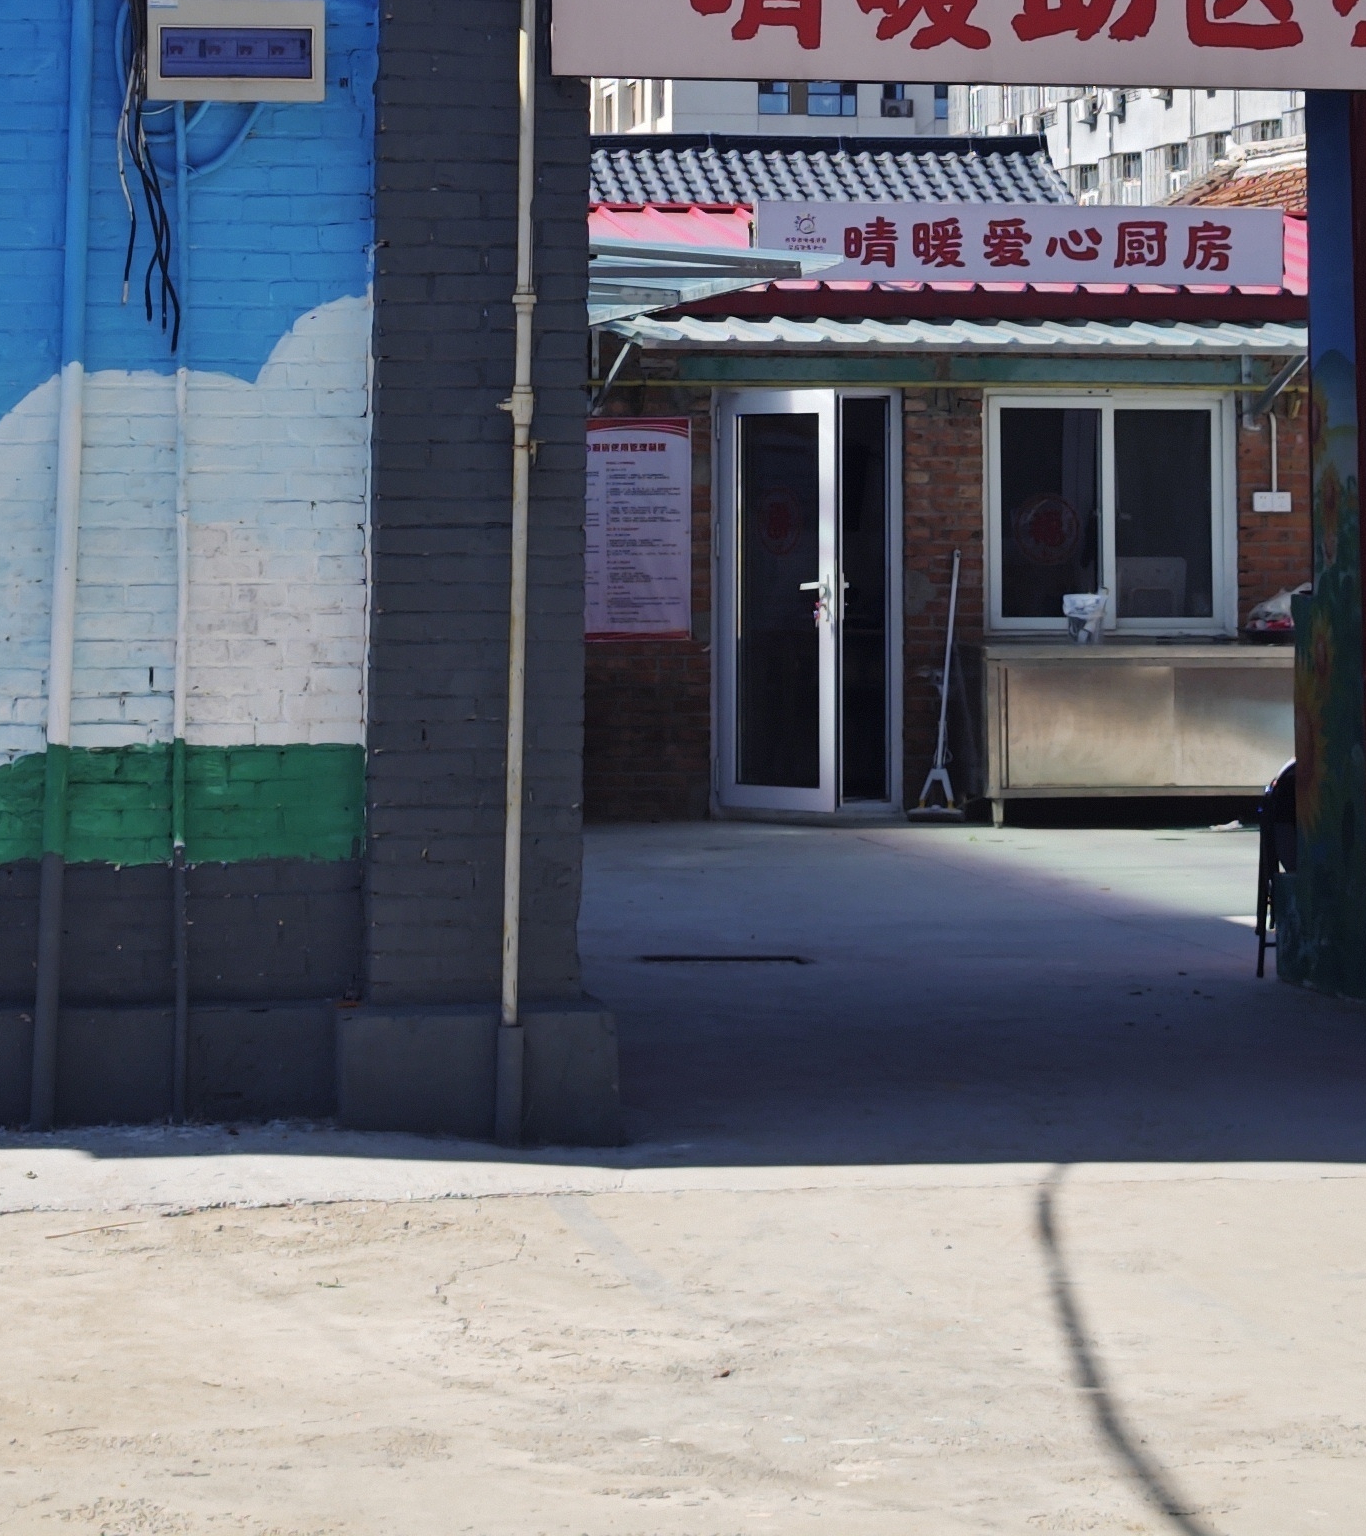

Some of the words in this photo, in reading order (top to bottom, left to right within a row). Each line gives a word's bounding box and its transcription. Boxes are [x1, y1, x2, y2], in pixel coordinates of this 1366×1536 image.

[843, 216, 1233, 271] 晴暖爱心厨房
